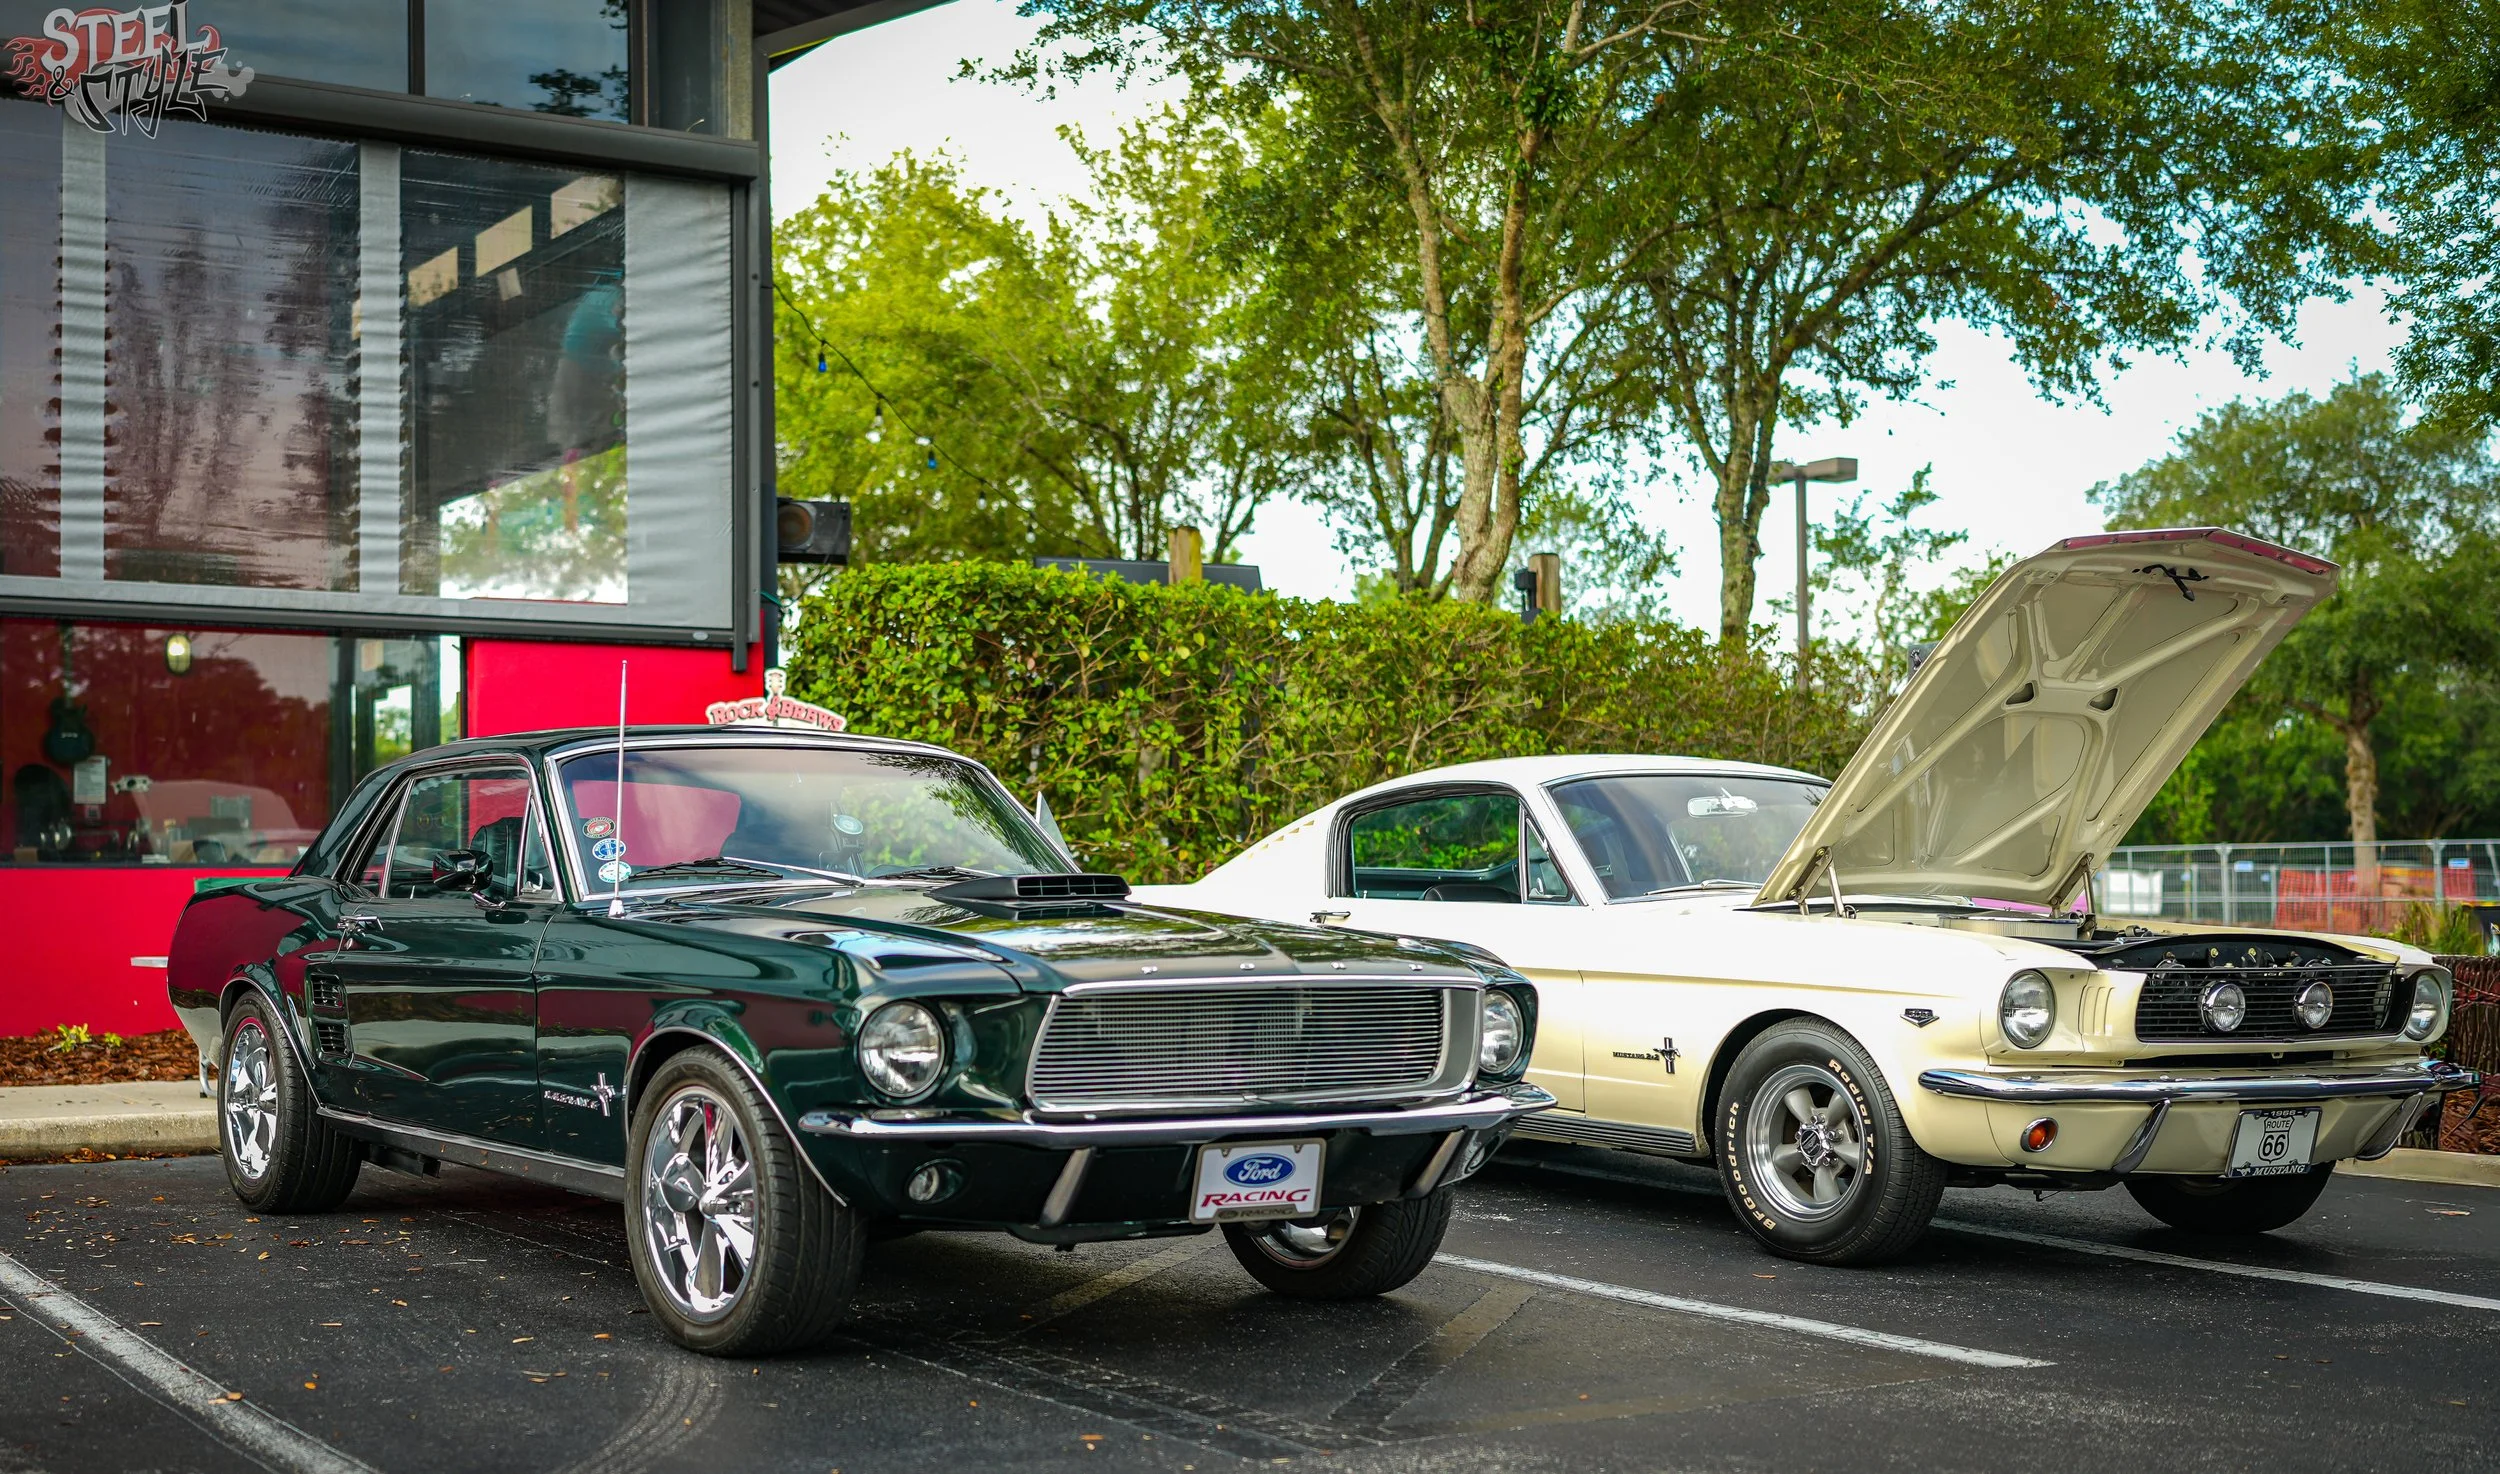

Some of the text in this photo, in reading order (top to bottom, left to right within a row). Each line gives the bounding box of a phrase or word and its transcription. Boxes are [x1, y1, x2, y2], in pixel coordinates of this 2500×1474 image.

[711, 701, 764, 725] ROCK
[779, 700, 845, 731] BREWS
[1828, 1059, 1874, 1175] Radial T/A
[2266, 1120, 2290, 1128] ROUTE
[2262, 1134, 2285, 1157] 66
[1238, 1159, 1282, 1182] Ford
[1726, 1102, 1776, 1230] BFGoodrich
[2253, 1165, 2305, 1175] MUSTANG
[1201, 1189, 1311, 1207] RACING
[1240, 1208, 1293, 1217] RACING
